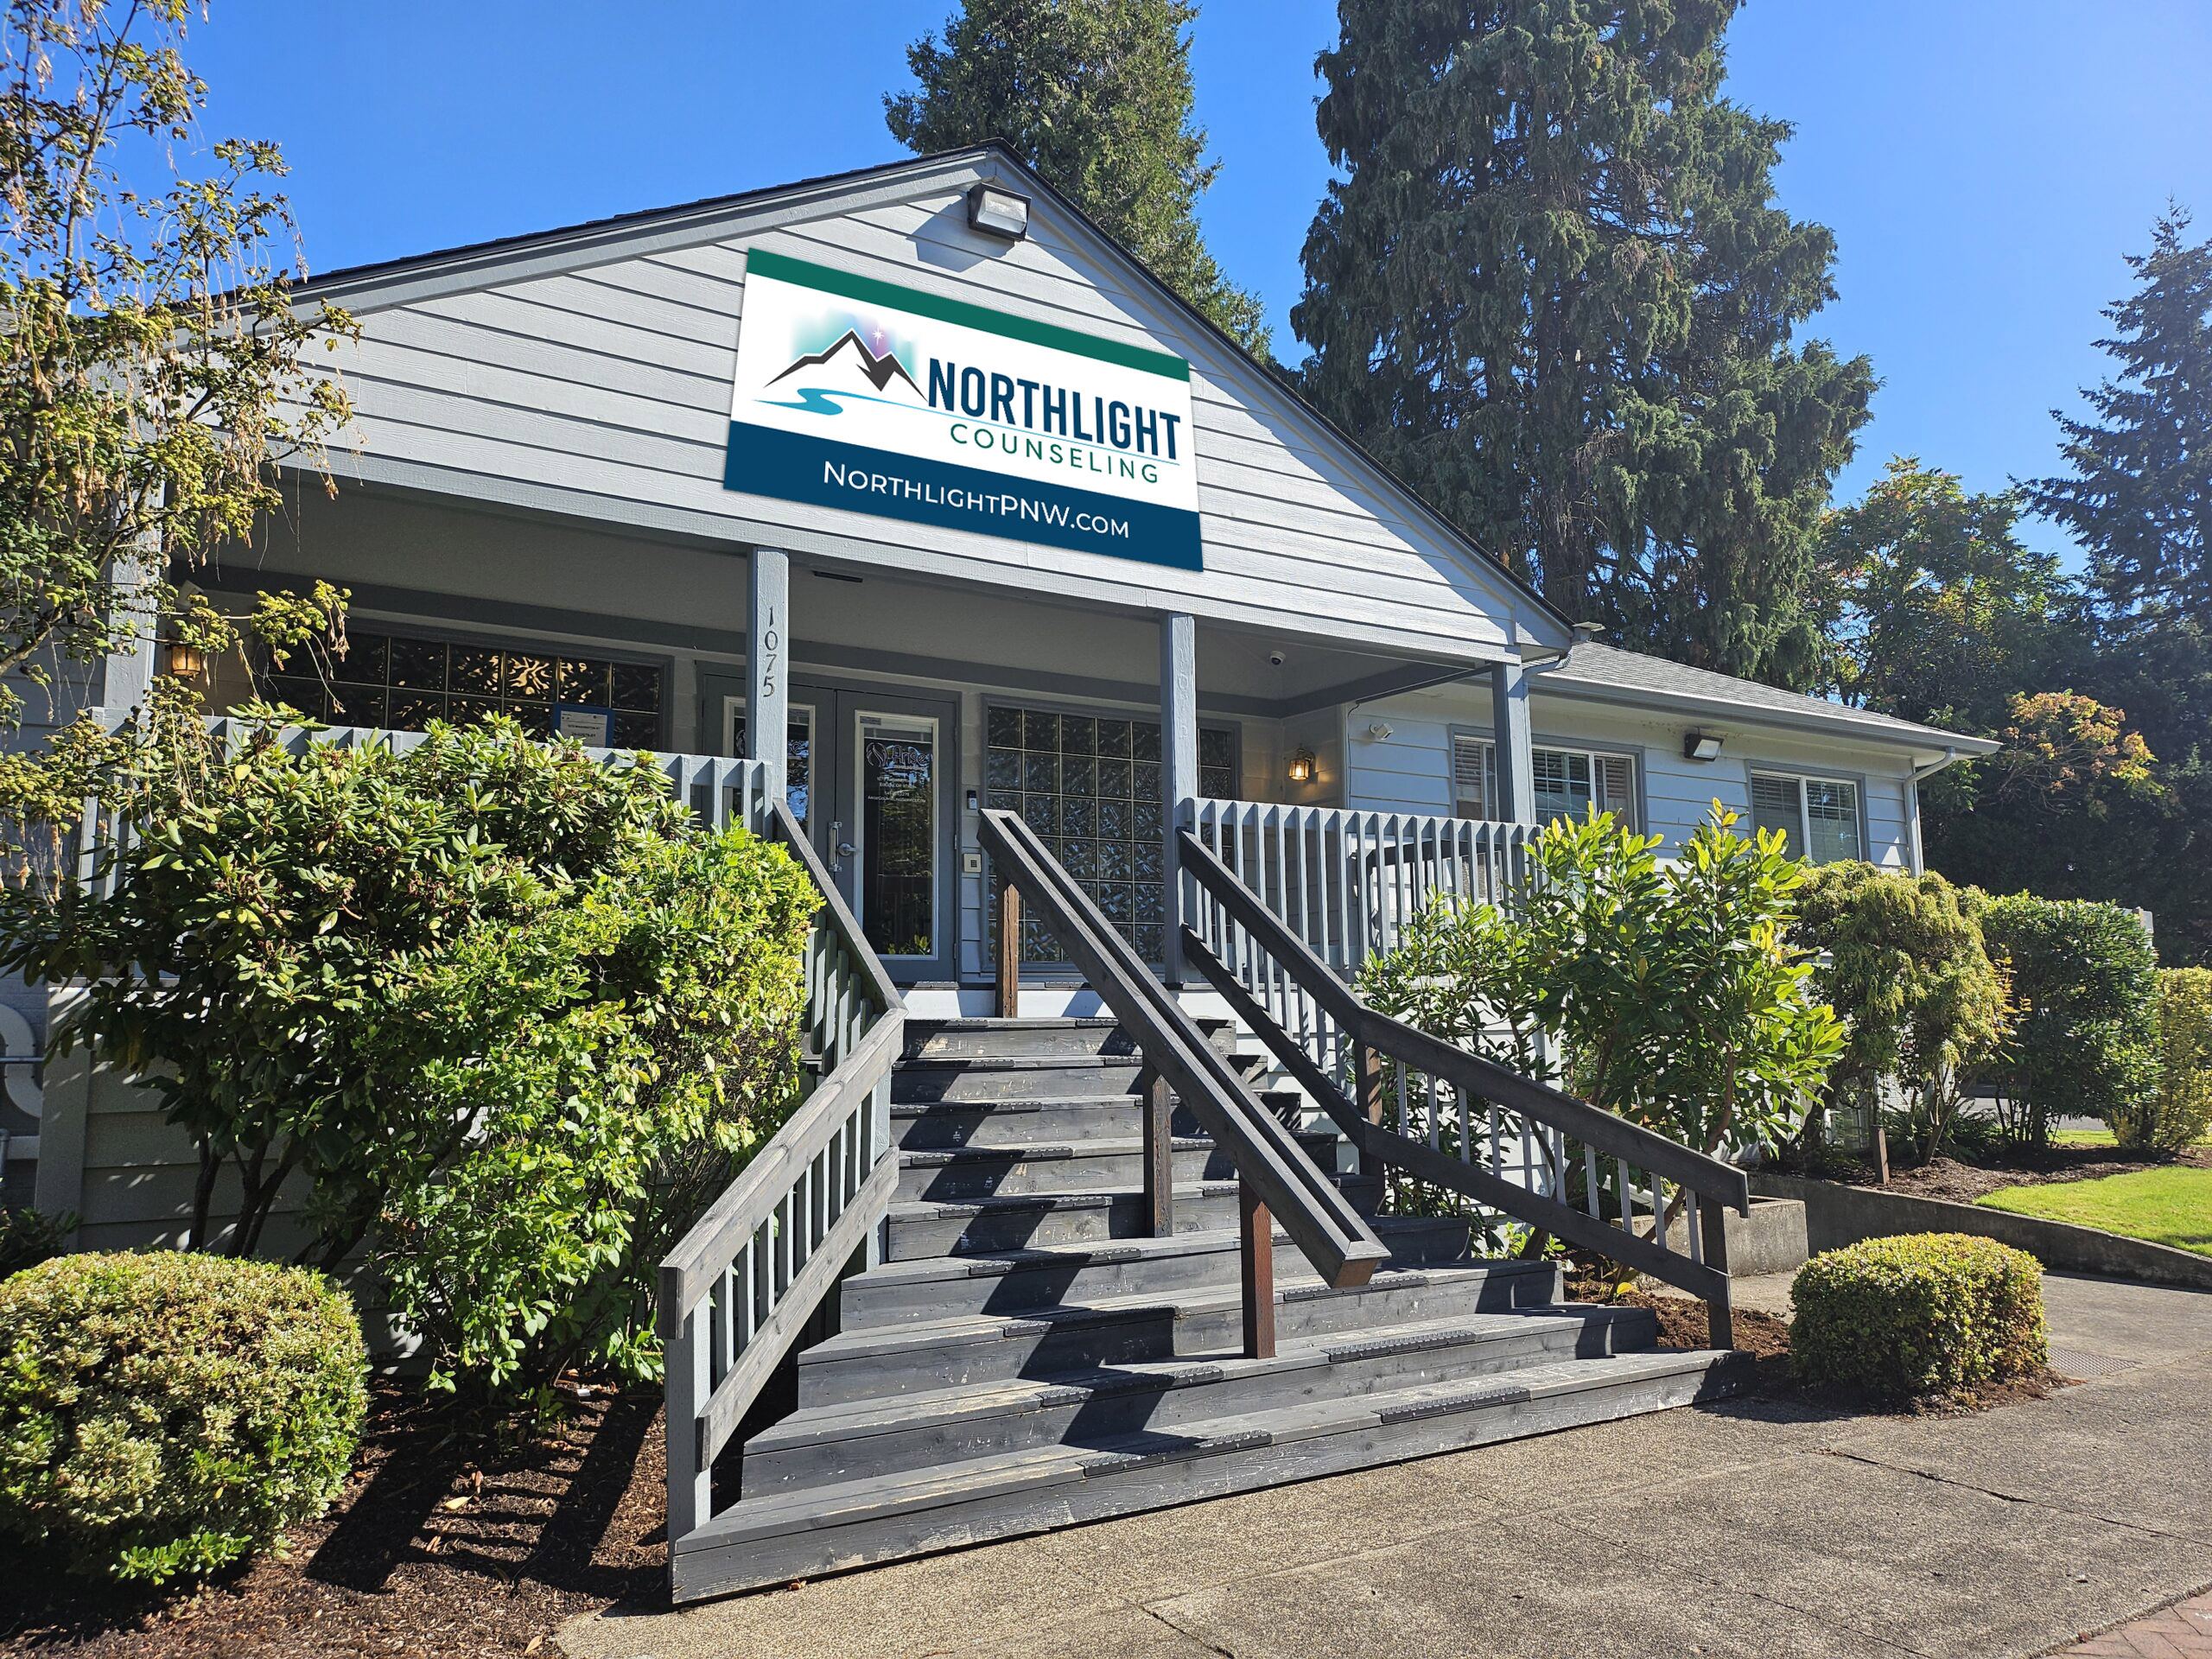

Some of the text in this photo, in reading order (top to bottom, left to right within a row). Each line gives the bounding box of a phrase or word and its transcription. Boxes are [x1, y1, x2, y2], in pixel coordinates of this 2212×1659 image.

[928, 358, 1181, 461] NORTHLIGHT
[950, 423, 1159, 484] COUNSELING
[762, 606, 779, 697] 1075
